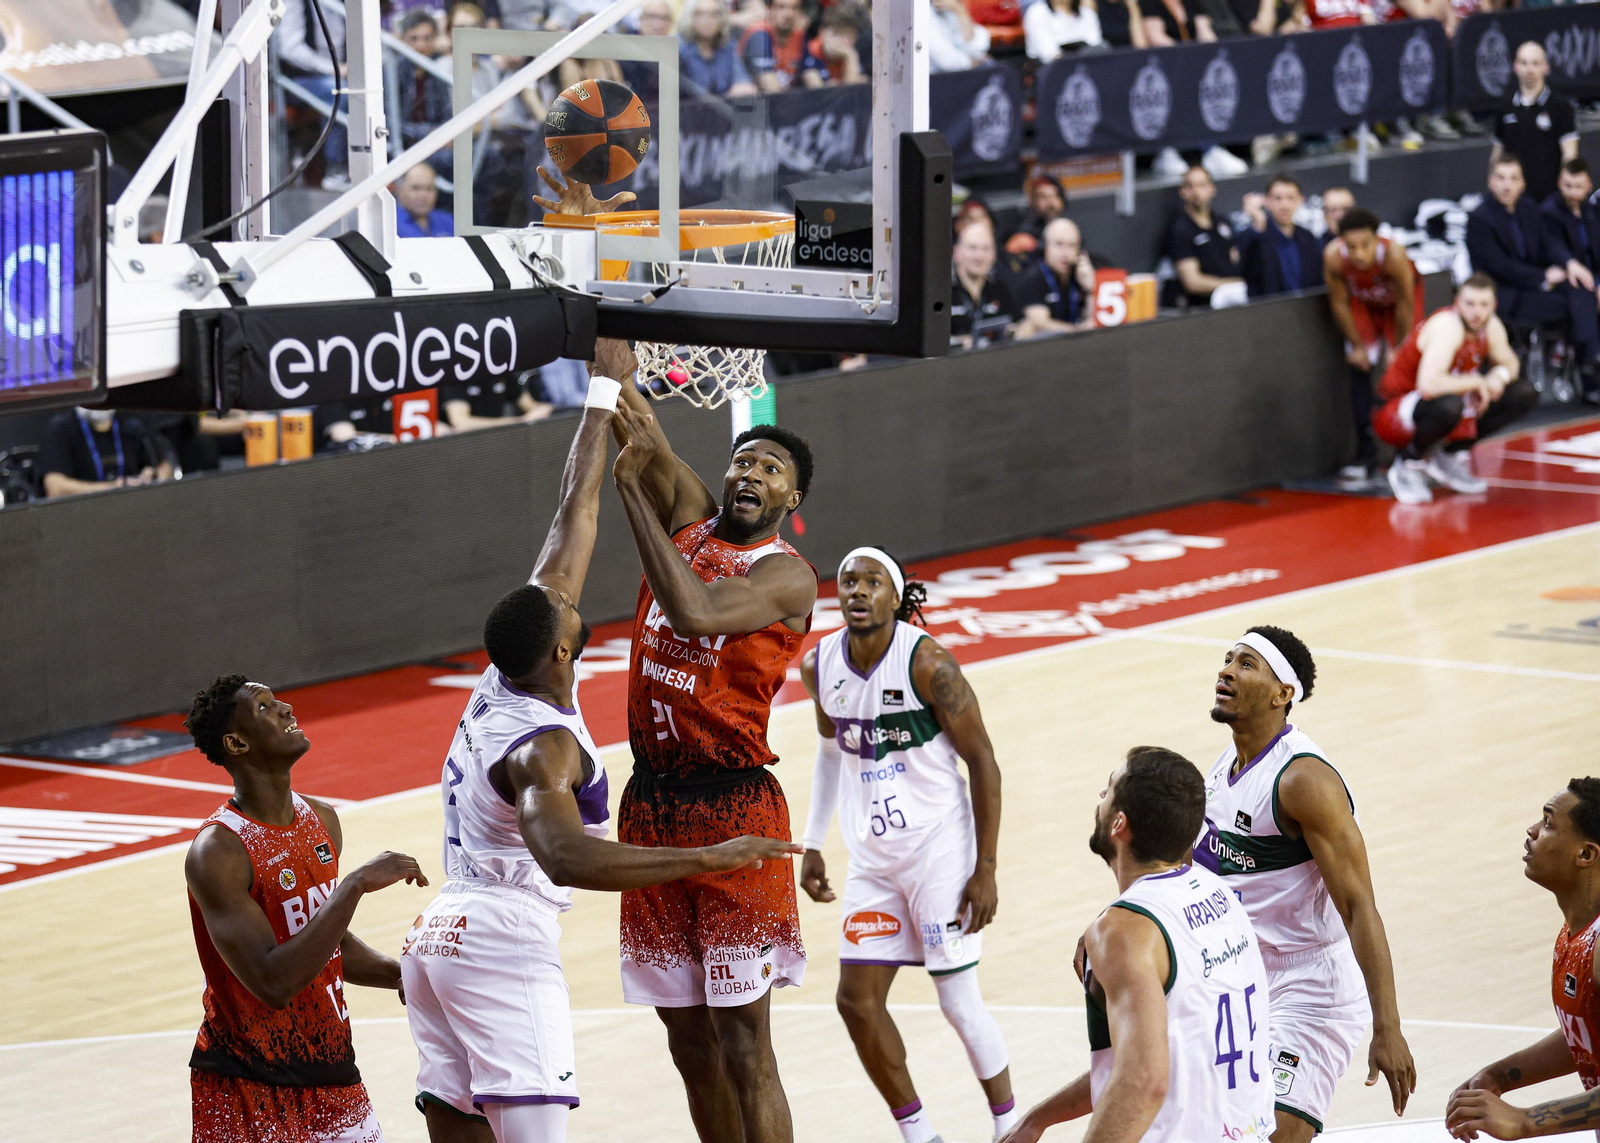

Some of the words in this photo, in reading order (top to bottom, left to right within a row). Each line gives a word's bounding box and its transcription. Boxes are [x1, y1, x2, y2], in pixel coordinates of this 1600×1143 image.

[799, 220, 832, 242] liga
[799, 241, 873, 264] endesa
[1096, 280, 1127, 328] 5
[268, 311, 519, 400] endesa
[400, 399, 434, 442] 5
[871, 795, 907, 837] 55
[1208, 834, 1256, 871] Unicaja
[1183, 888, 1231, 931] KRAVISH
[428, 915, 467, 931] COSTA
[420, 931, 436, 942] DEL
[437, 931, 463, 945] SOL
[416, 942, 460, 958] MÁLAGA
[709, 947, 756, 963] Adbisio
[710, 965, 735, 981] ETL
[711, 980, 758, 995] GLOBAL
[1279, 1055, 1295, 1066] acb
